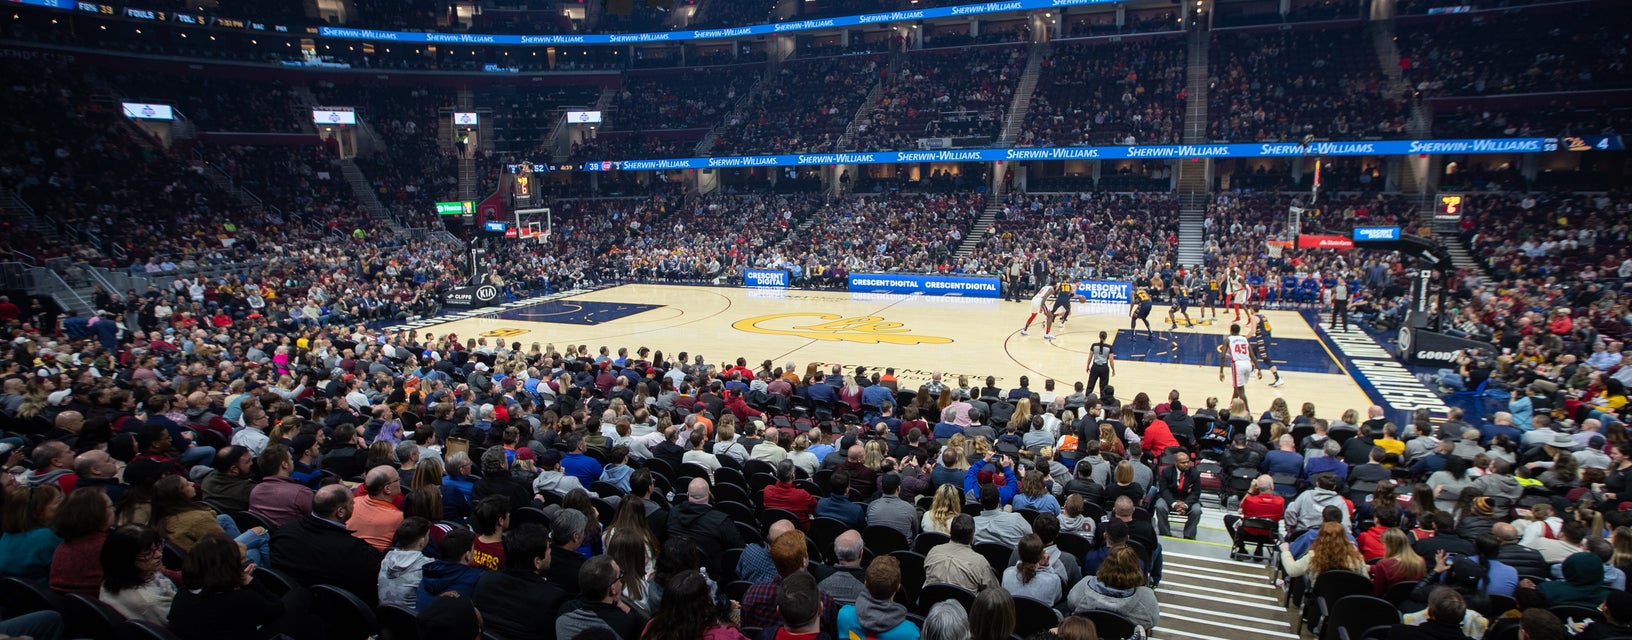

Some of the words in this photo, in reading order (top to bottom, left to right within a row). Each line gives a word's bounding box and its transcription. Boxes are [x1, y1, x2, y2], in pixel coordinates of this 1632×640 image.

[127, 8, 155, 19] FOULS
[747, 272, 784, 281] CRESCENT
[852, 279, 890, 287] CRESCENT
[890, 280, 919, 288] DIGITAL
[925, 281, 967, 290] CRESCENT
[965, 283, 997, 291] DIGITAL
[1078, 283, 1128, 292] CRESCENT
[1091, 290, 1128, 299] DIGITAL
[1235, 344, 1248, 355] 45
